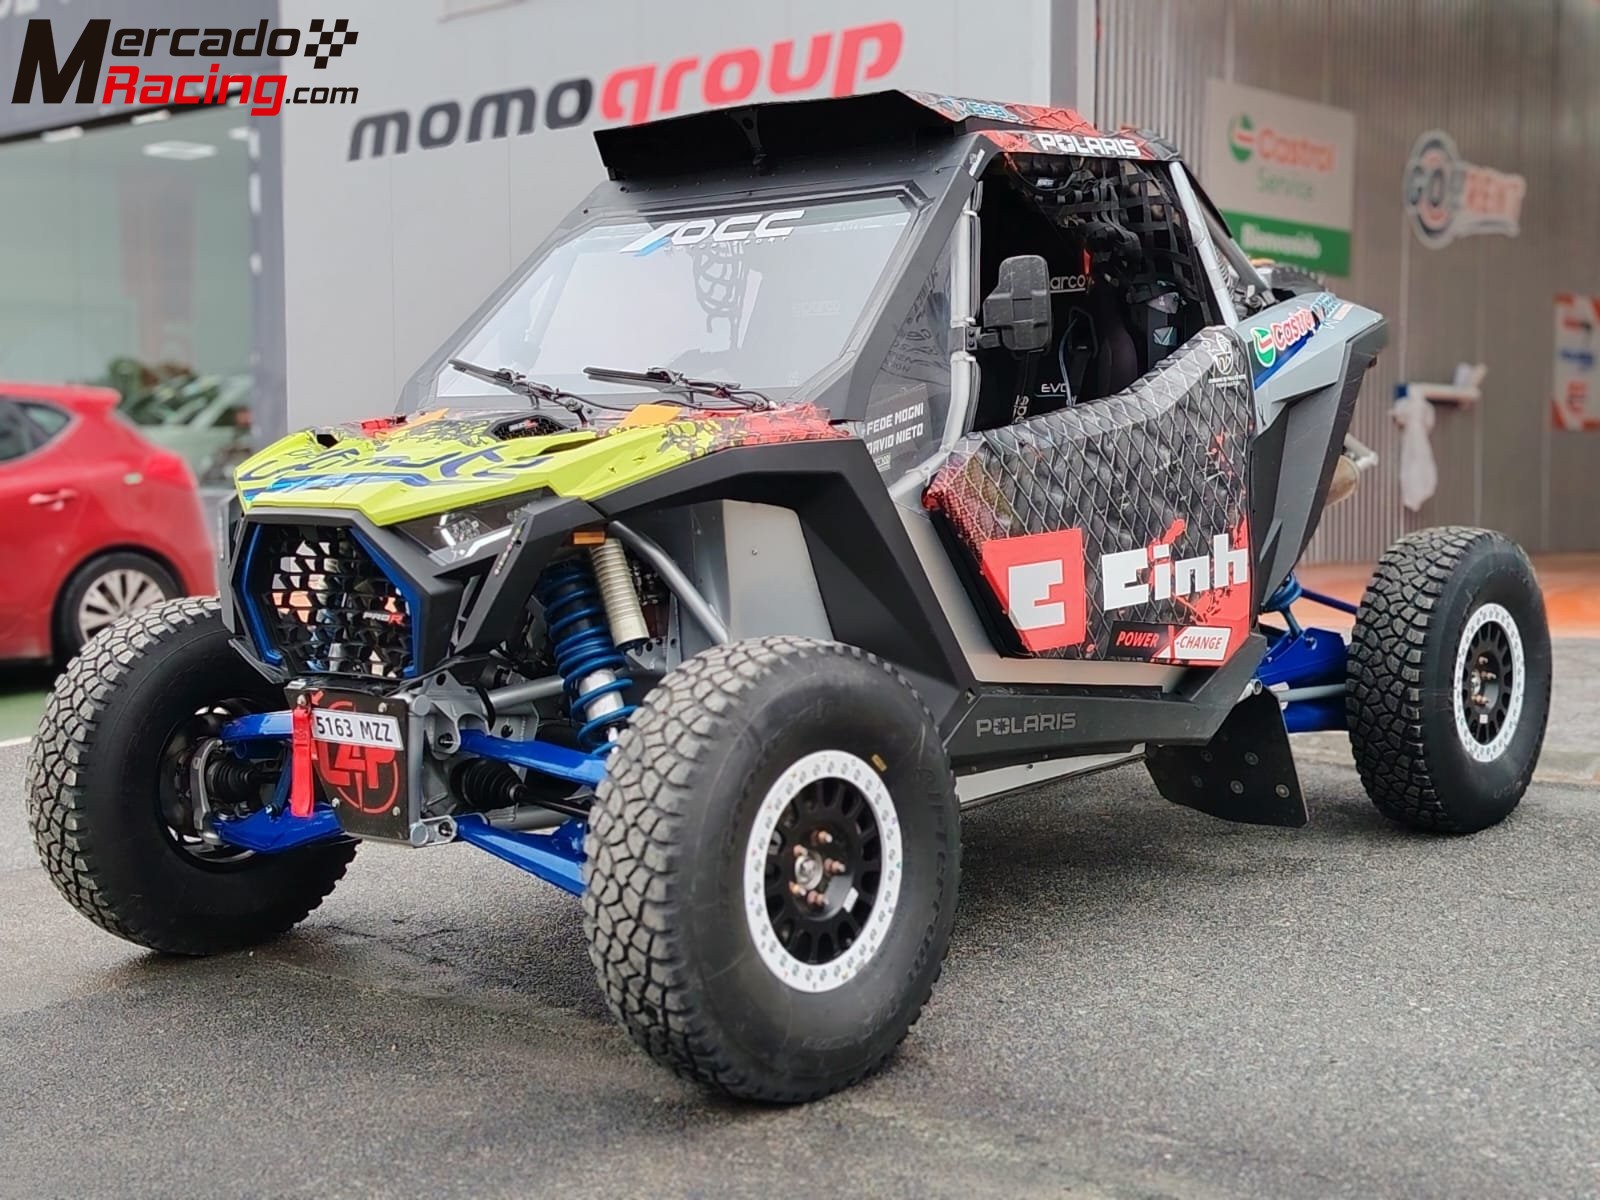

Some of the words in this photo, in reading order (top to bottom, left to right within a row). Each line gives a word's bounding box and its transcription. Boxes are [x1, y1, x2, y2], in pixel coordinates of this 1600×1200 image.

[1038, 133, 1141, 157] POLARIS
[1257, 127, 1337, 174] Castrol
[1049, 274, 1087, 290] arco
[866, 414, 893, 435] FEDE
[894, 402, 924, 425] MOGNI
[866, 434, 895, 455] DAVID
[896, 422, 924, 445] NIETO
[1116, 630, 1160, 649] POWER
[315, 715, 354, 738] 5163
[359, 719, 393, 743] MZZ
[976, 712, 1077, 737] POLARIS
